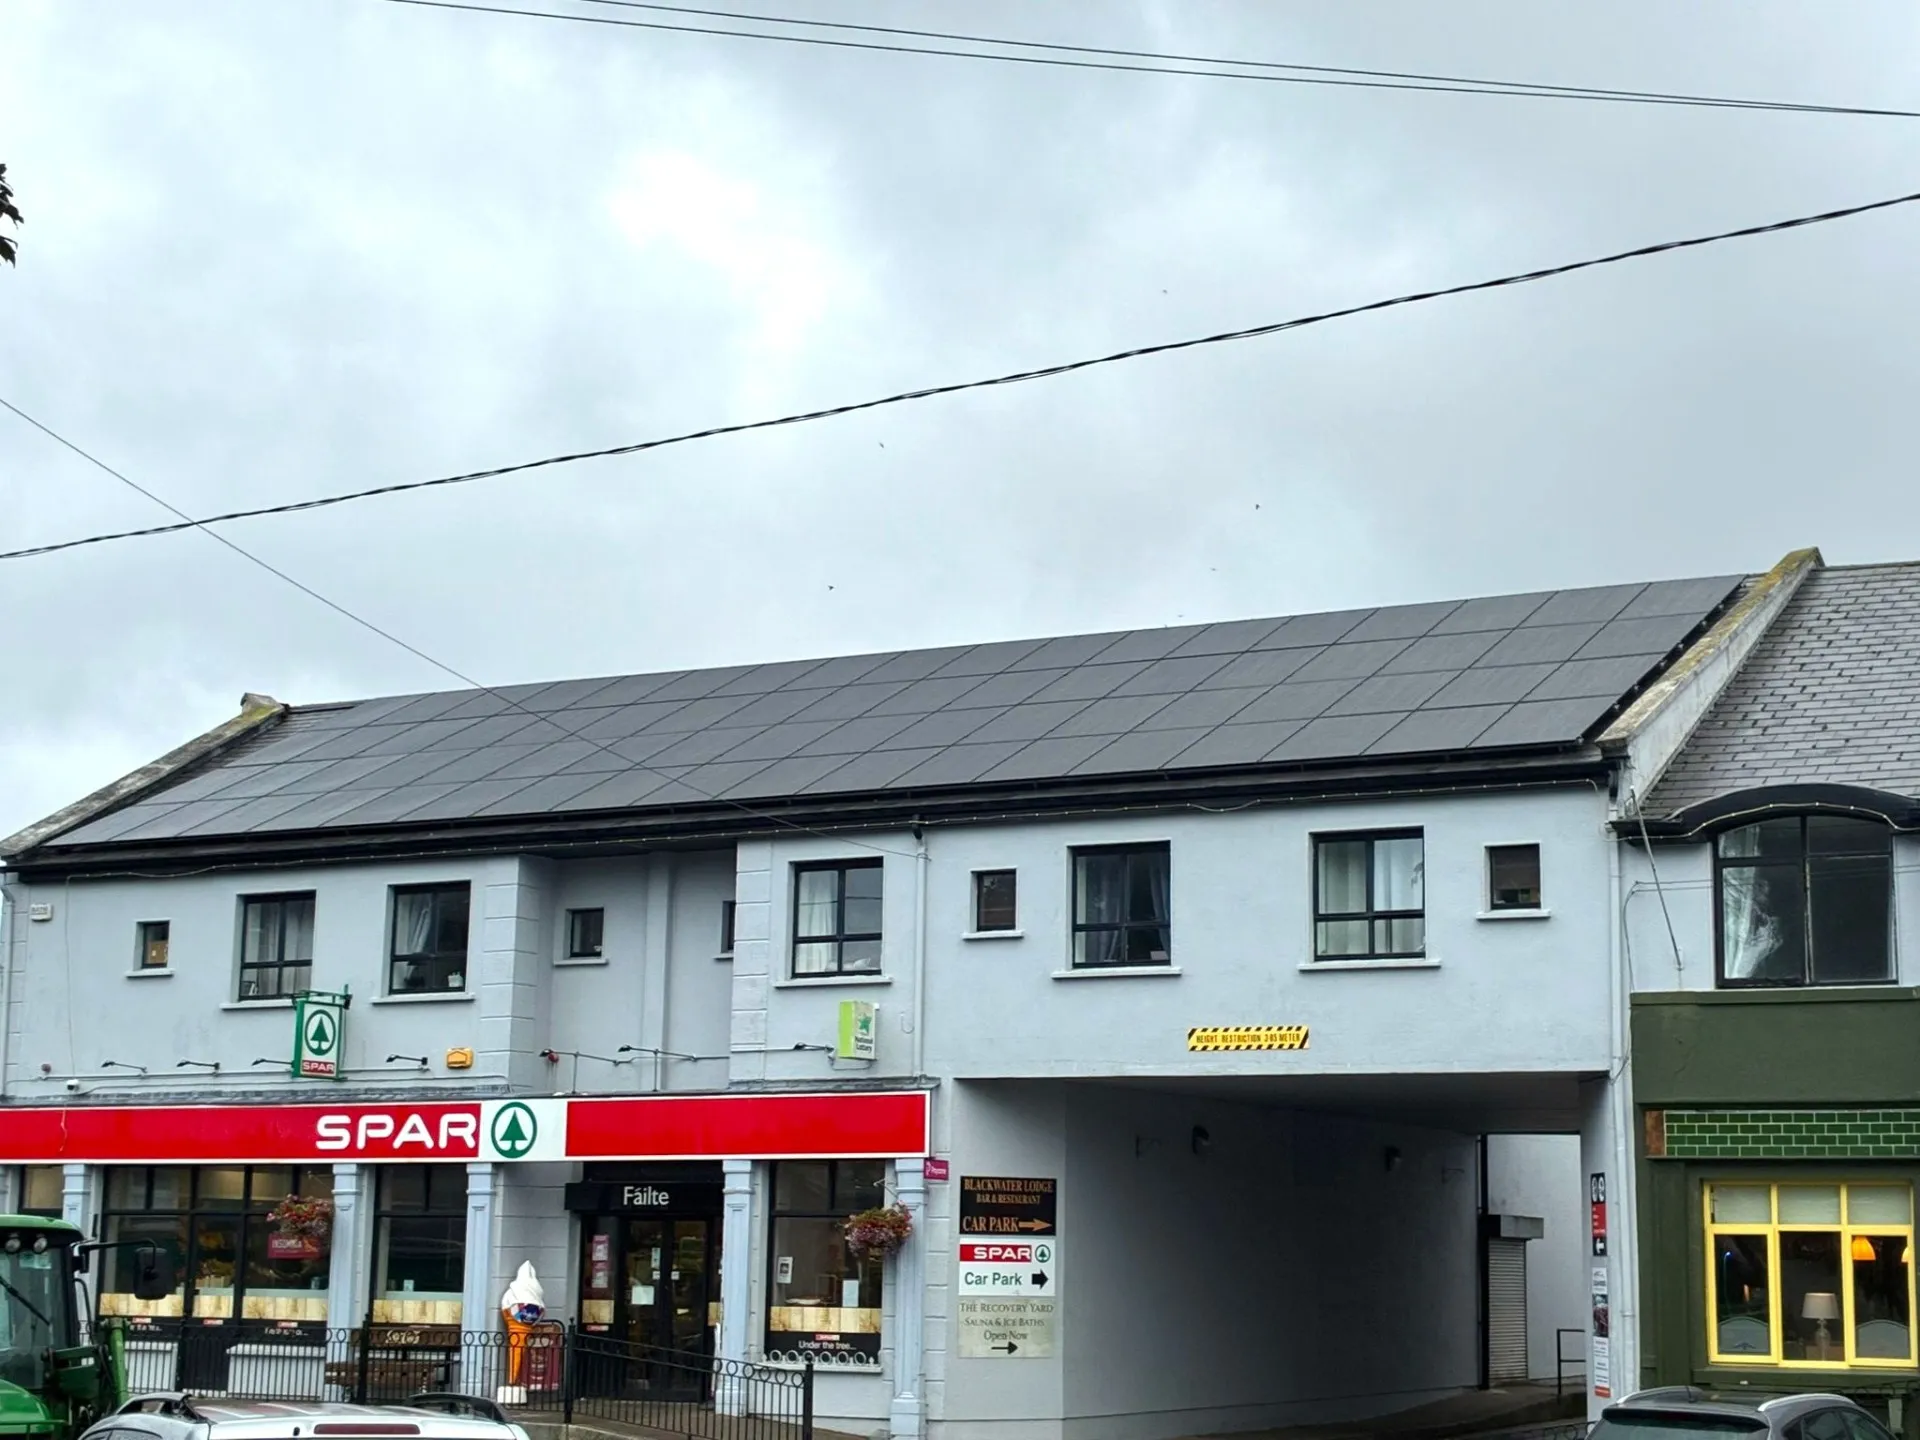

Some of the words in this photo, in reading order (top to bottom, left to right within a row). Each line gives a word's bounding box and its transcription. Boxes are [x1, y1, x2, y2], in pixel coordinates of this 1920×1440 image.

[1196, 1034, 1218, 1043] HEIGHT
[1221, 1034, 1261, 1043] RESTRICTION
[1280, 1033, 1300, 1042] METER
[303, 1061, 334, 1071] SPAR
[315, 1113, 477, 1150] SPAR
[964, 1178, 1022, 1192] BLACKWATER
[1024, 1179, 1054, 1193] LODGE
[623, 1186, 669, 1206] Fáilte
[976, 1193, 990, 1204] BAR
[962, 1216, 987, 1232] CAR
[989, 1216, 1019, 1232] PARK
[973, 1246, 1031, 1260] SPAR
[964, 1271, 988, 1285] Car
[992, 1272, 1023, 1286] Park
[960, 1303, 979, 1313] THE
[980, 1303, 1028, 1313] RECOVERY
[1030, 1303, 1054, 1313] YARD
[994, 1317, 1002, 1327] &
[1003, 1317, 1017, 1327] ICE
[1019, 1317, 1045, 1327] BATHS
[984, 1330, 1007, 1342] Open
[1009, 1330, 1028, 1340] Now
[798, 1340, 821, 1349] Under
[822, 1341, 835, 1350] the
